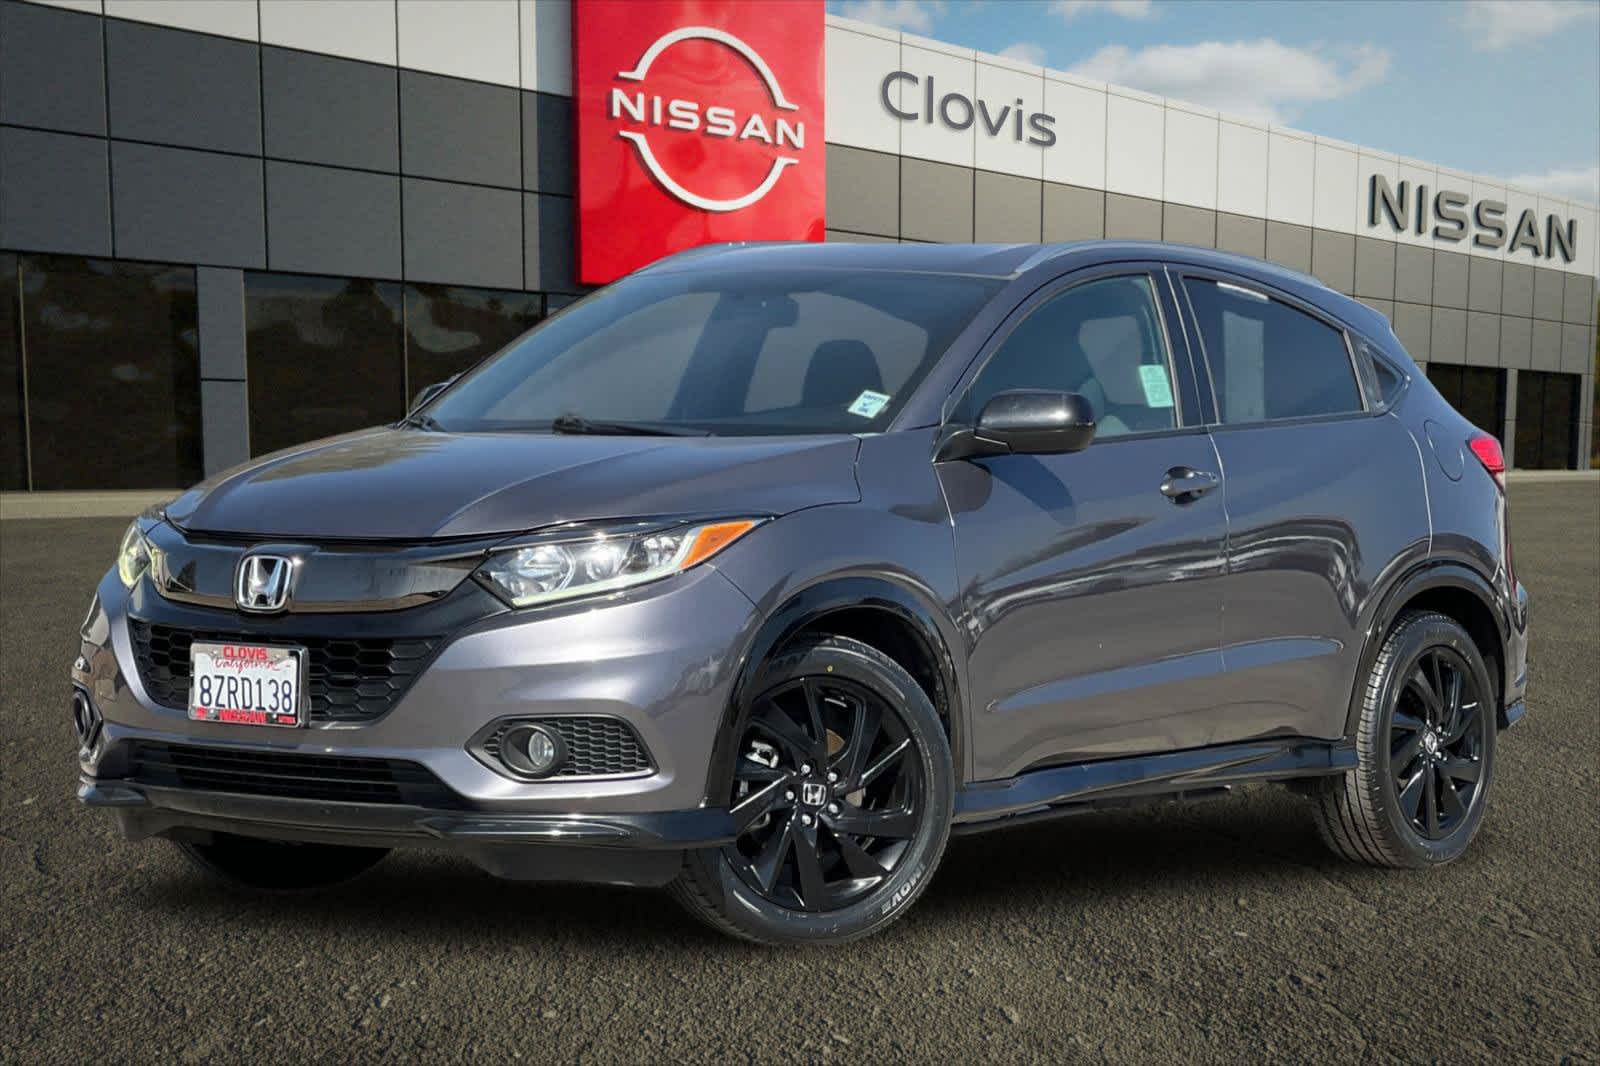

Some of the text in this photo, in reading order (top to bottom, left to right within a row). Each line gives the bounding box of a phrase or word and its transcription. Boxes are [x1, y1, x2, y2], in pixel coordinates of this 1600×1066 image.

[611, 87, 805, 149] NISSAN
[881, 71, 1057, 147] Clovis
[1368, 173, 1578, 263] NISSAN
[223, 644, 268, 660] CLOVIS
[200, 674, 292, 713] 8ZRD138
